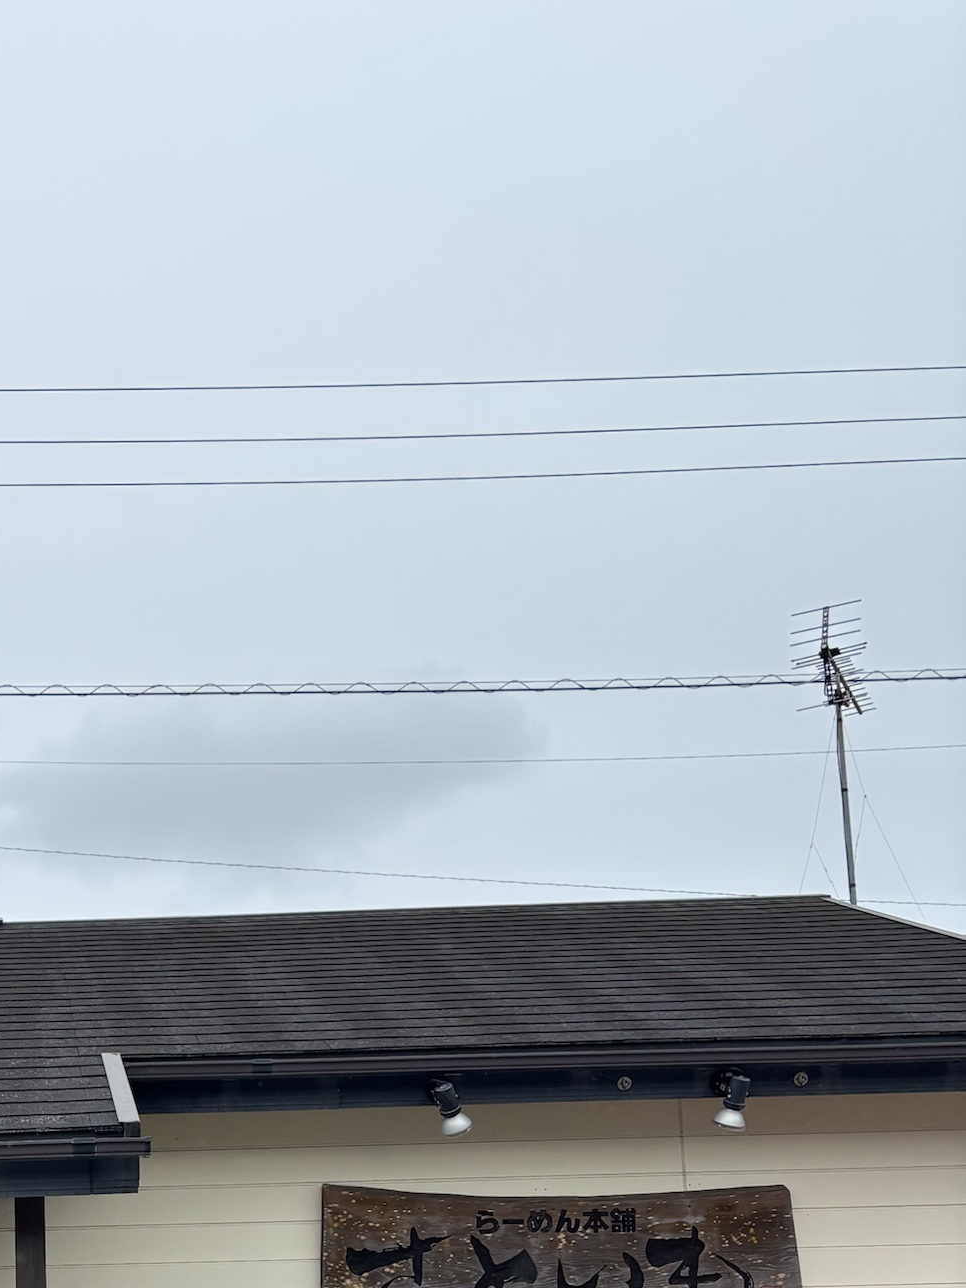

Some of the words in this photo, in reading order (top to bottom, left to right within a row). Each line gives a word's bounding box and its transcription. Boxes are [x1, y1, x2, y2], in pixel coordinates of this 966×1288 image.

[476, 1208, 637, 1235] らーめん本舗
